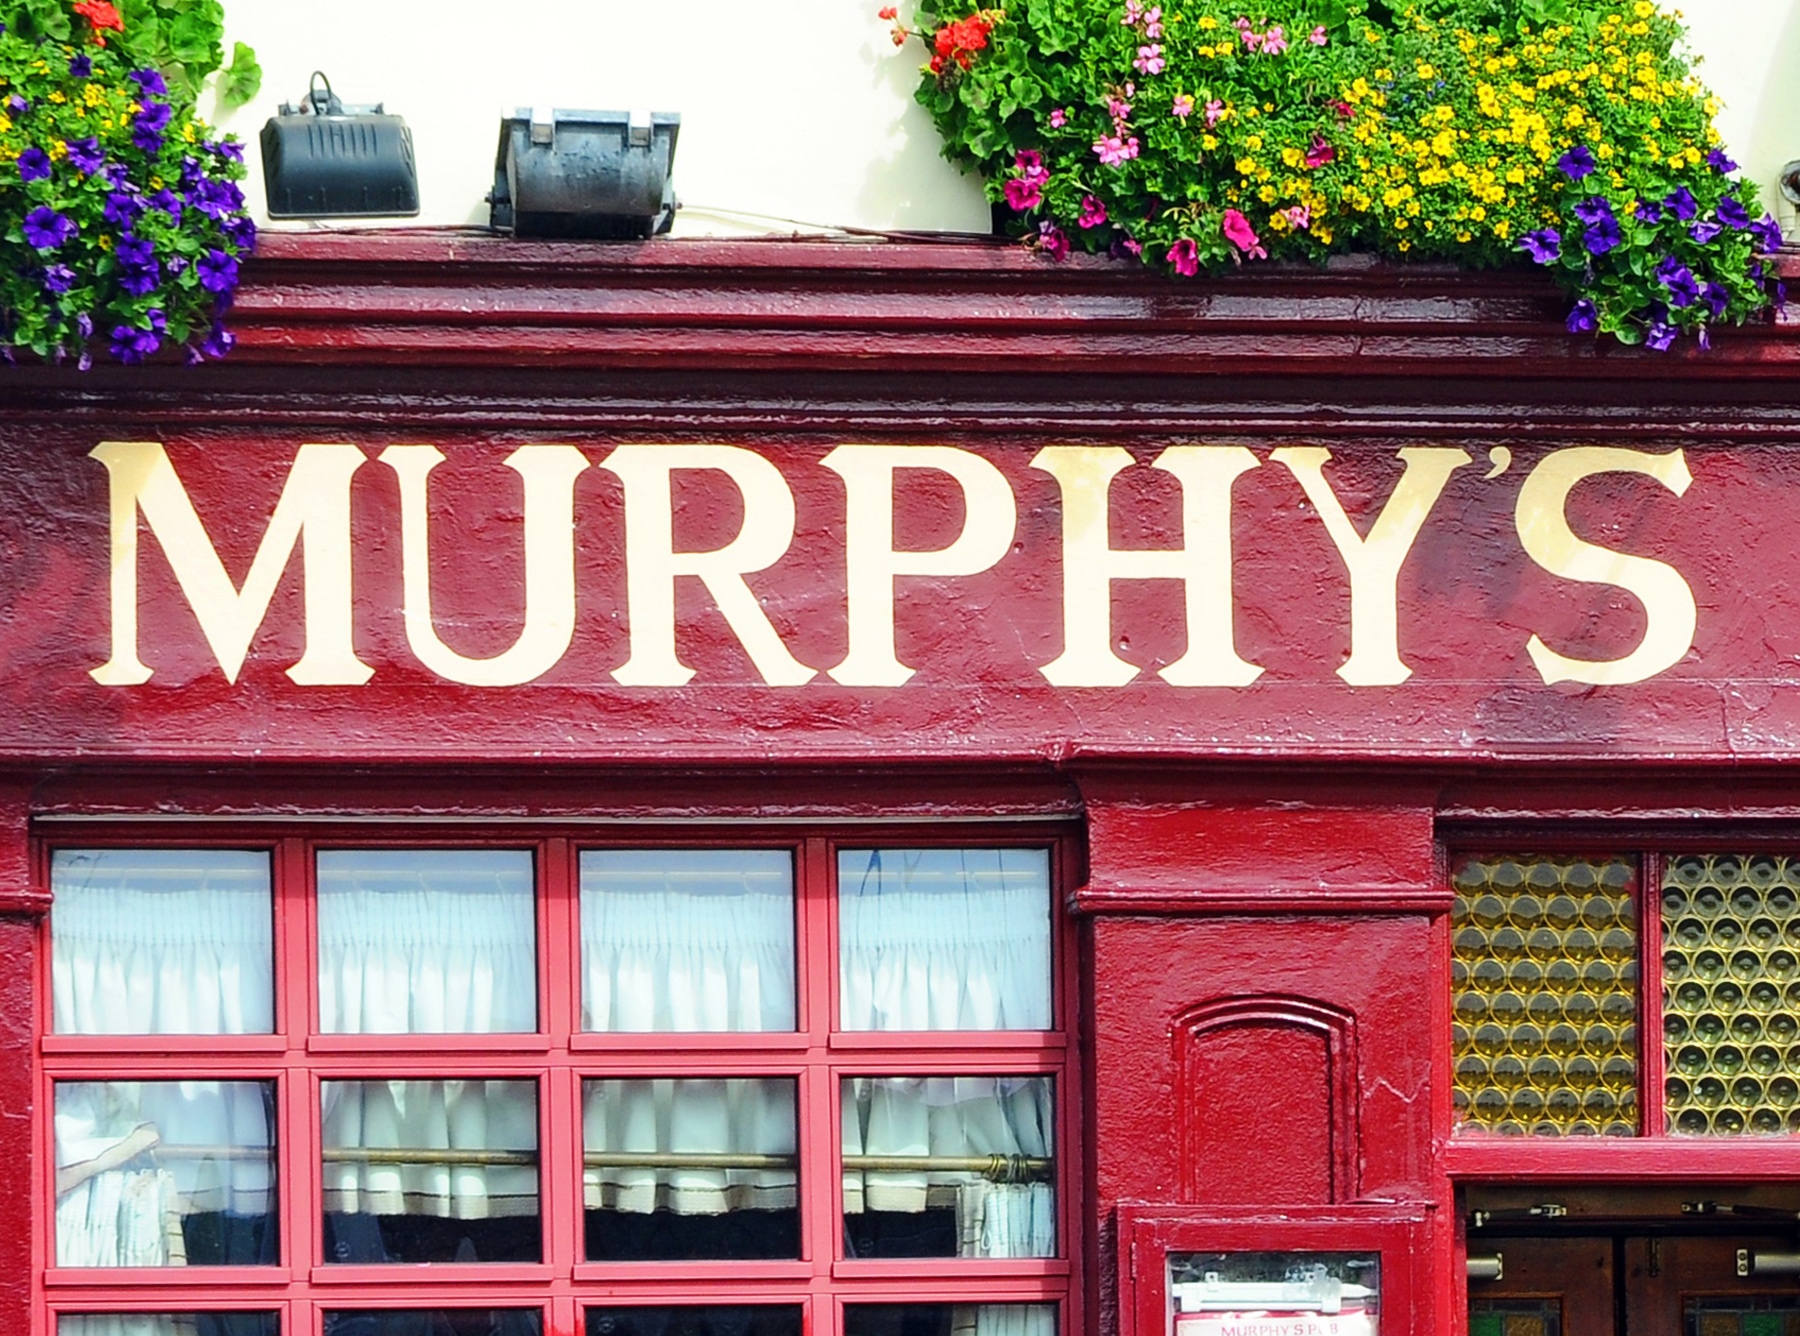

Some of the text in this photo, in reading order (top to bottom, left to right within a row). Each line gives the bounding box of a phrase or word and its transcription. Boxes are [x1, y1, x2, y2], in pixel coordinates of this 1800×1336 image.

[87, 441, 1697, 688] MURPHY'S
[1221, 1322, 1339, 1336] MURPHY'S PB
